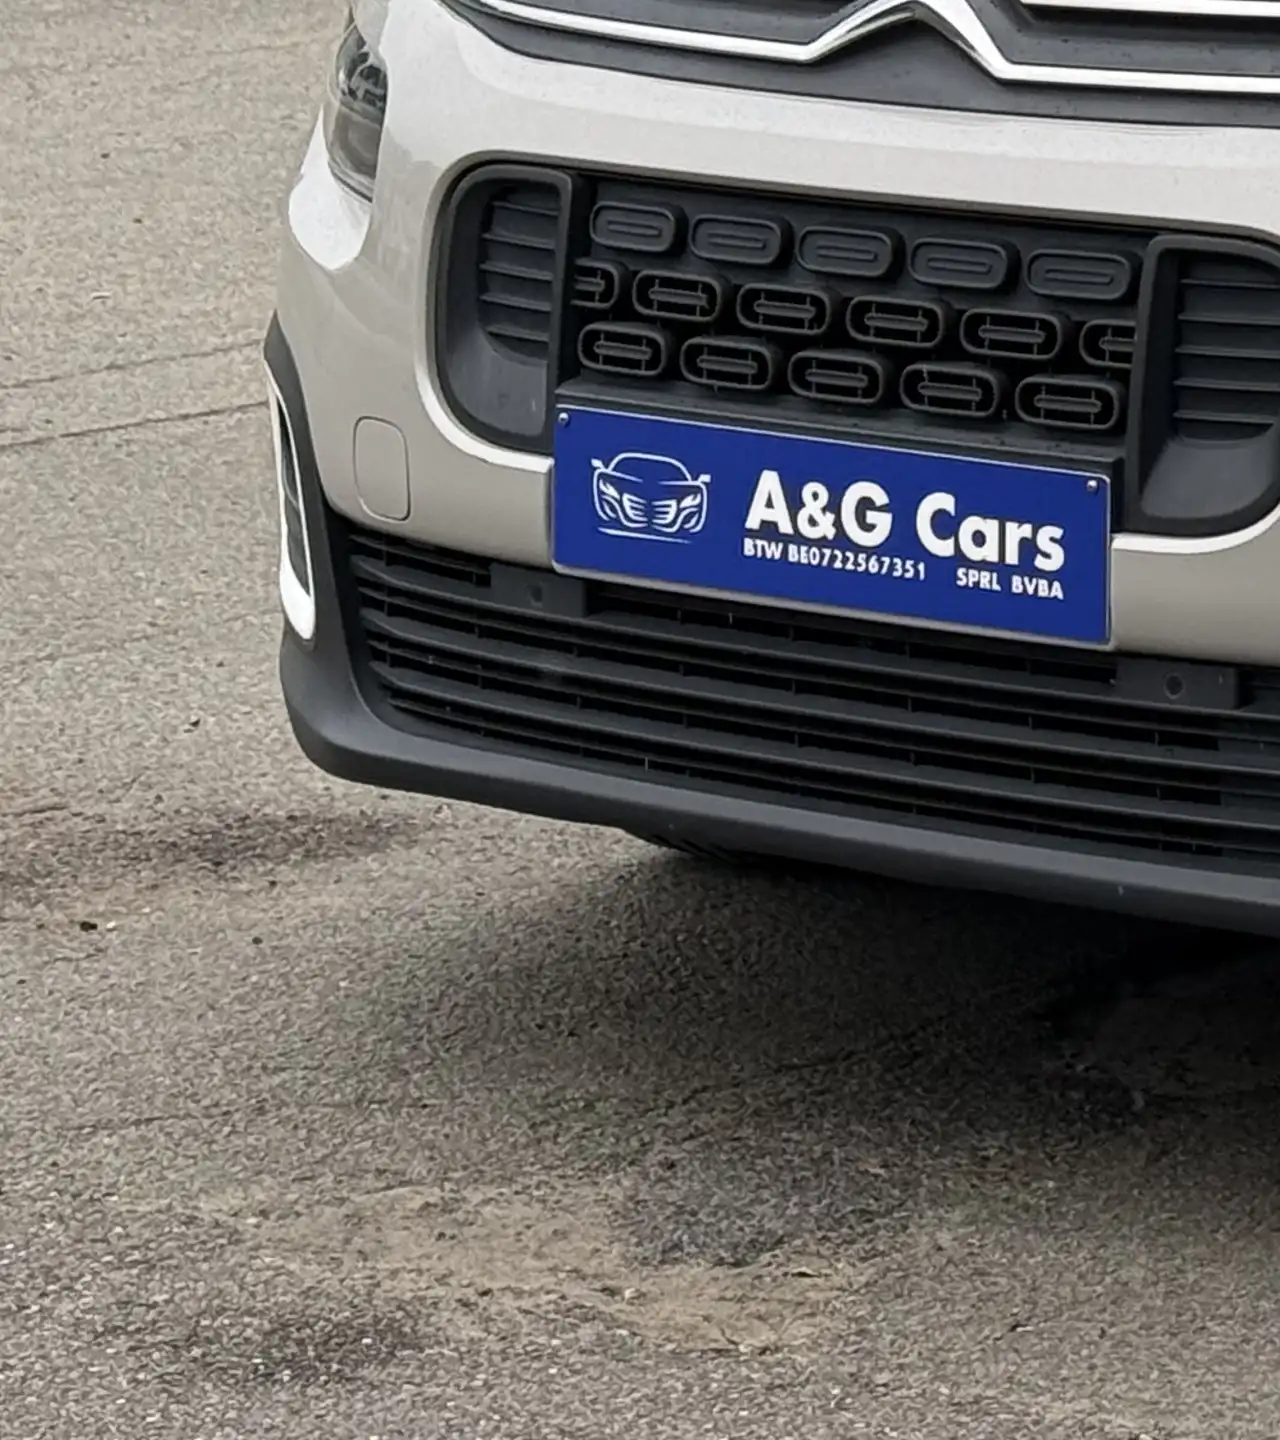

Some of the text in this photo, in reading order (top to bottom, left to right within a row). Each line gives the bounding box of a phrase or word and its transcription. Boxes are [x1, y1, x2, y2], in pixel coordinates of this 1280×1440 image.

[744, 469, 1065, 572] A&G Cars
[743, 537, 1065, 600] BTW BE0722567351 SPRL BVBA
